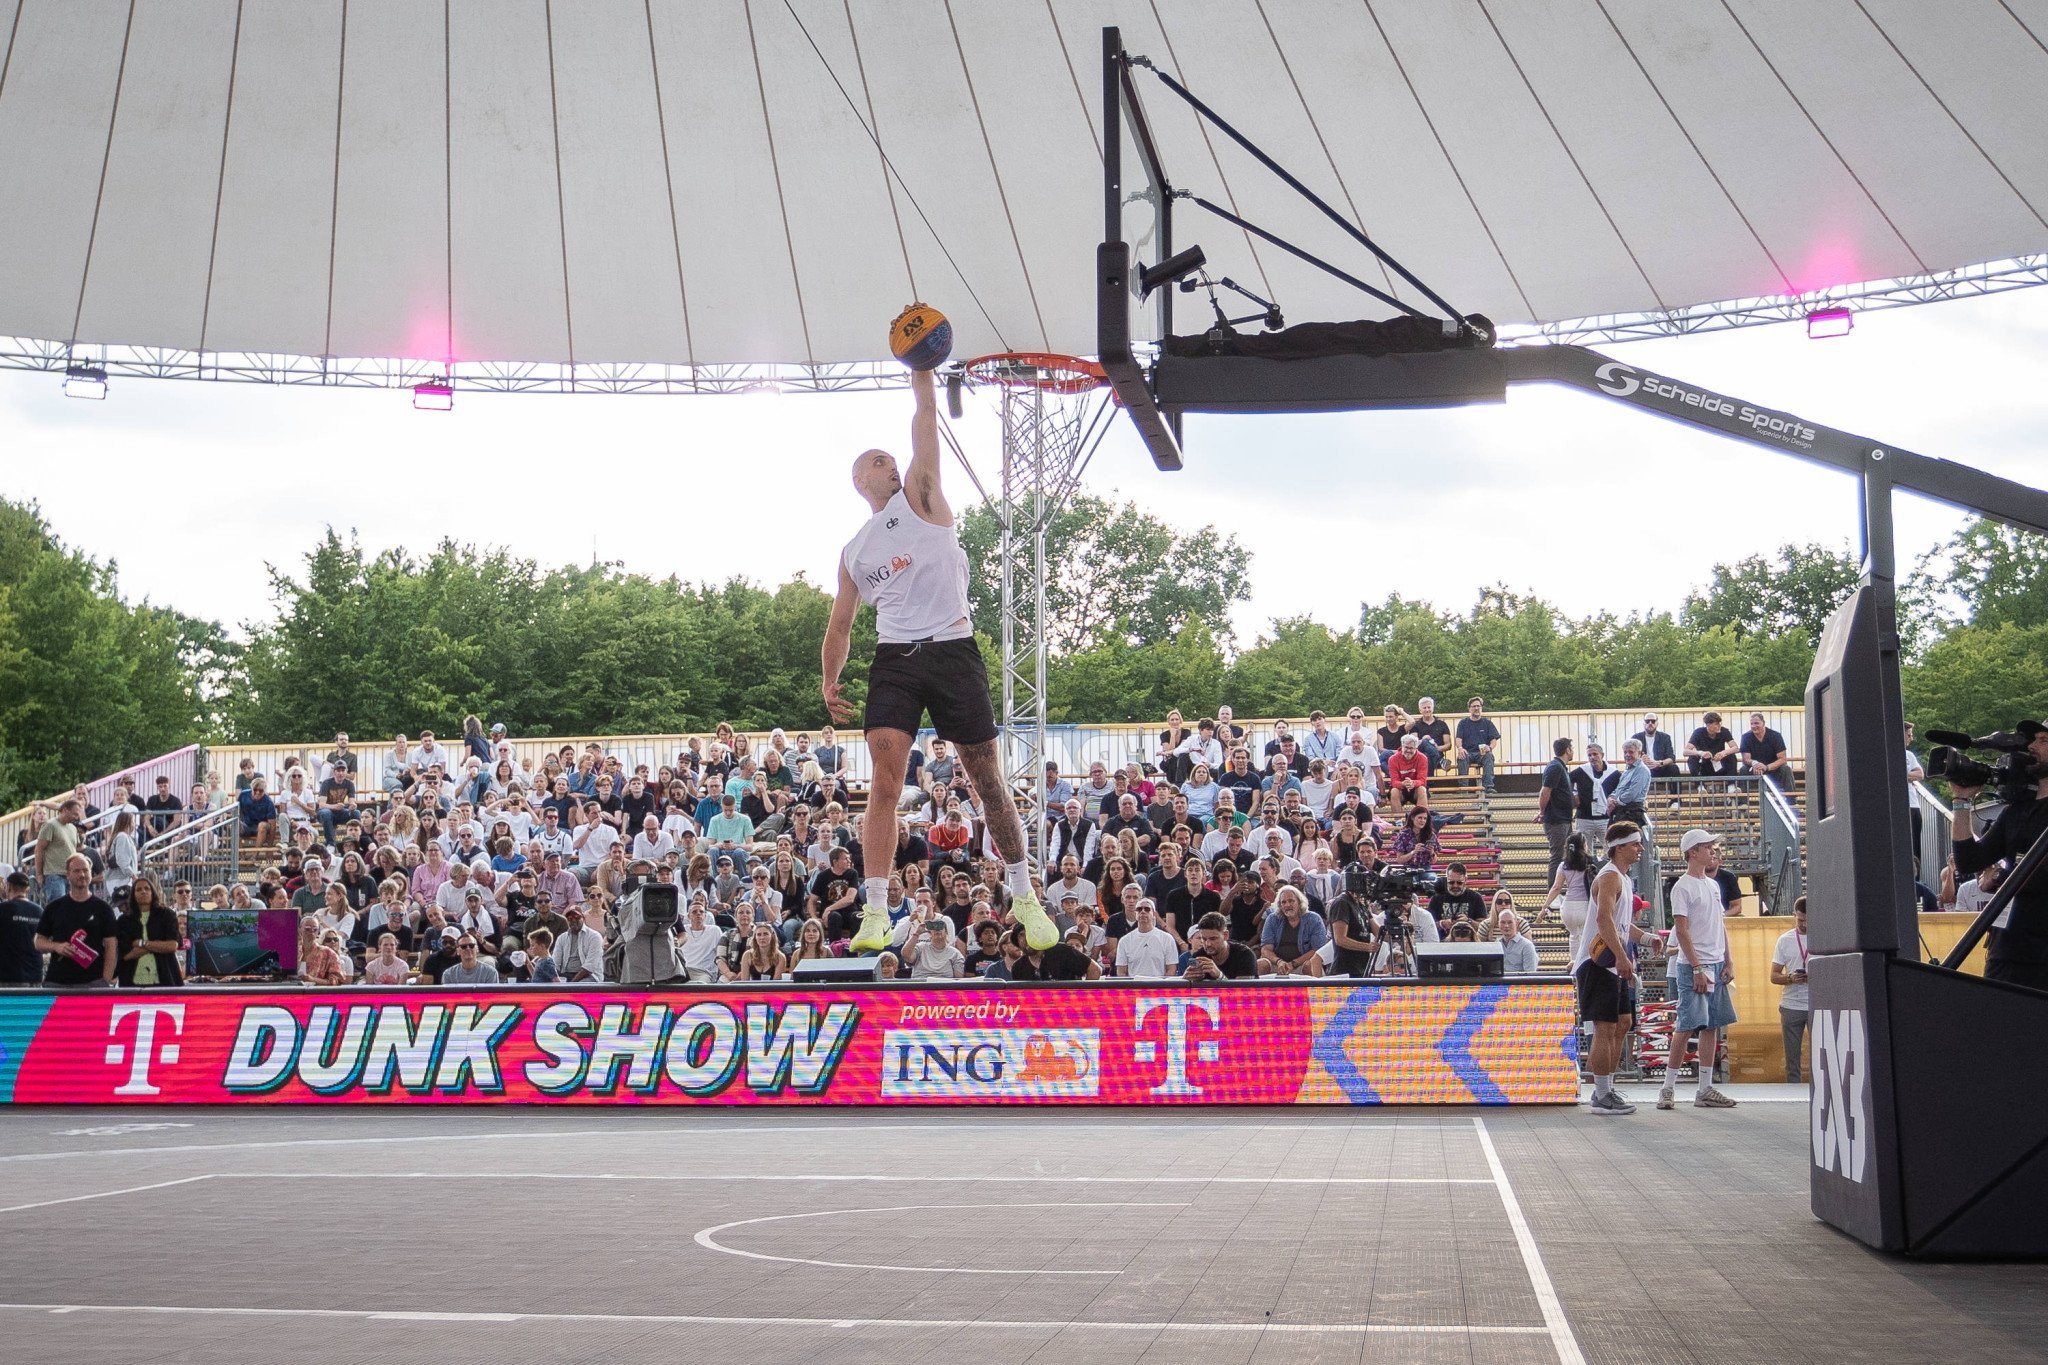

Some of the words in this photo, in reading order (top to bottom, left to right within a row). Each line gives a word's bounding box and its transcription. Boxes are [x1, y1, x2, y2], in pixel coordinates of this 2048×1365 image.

[1643, 377, 1734, 416] Schelde
[1739, 407, 1815, 440] Sports
[1756, 426, 1781, 440] Superior
[1782, 434, 1791, 443] by
[1790, 437, 1812, 449] Design
[865, 565, 891, 589] ING
[900, 1000, 991, 1024] powered
[994, 1000, 1021, 1023] by
[105, 1003, 185, 1095] T
[222, 1003, 522, 1096] DUNK
[523, 1002, 861, 1096] SHOW
[894, 1044, 1006, 1082] ING
[1133, 996, 1221, 1095] T
